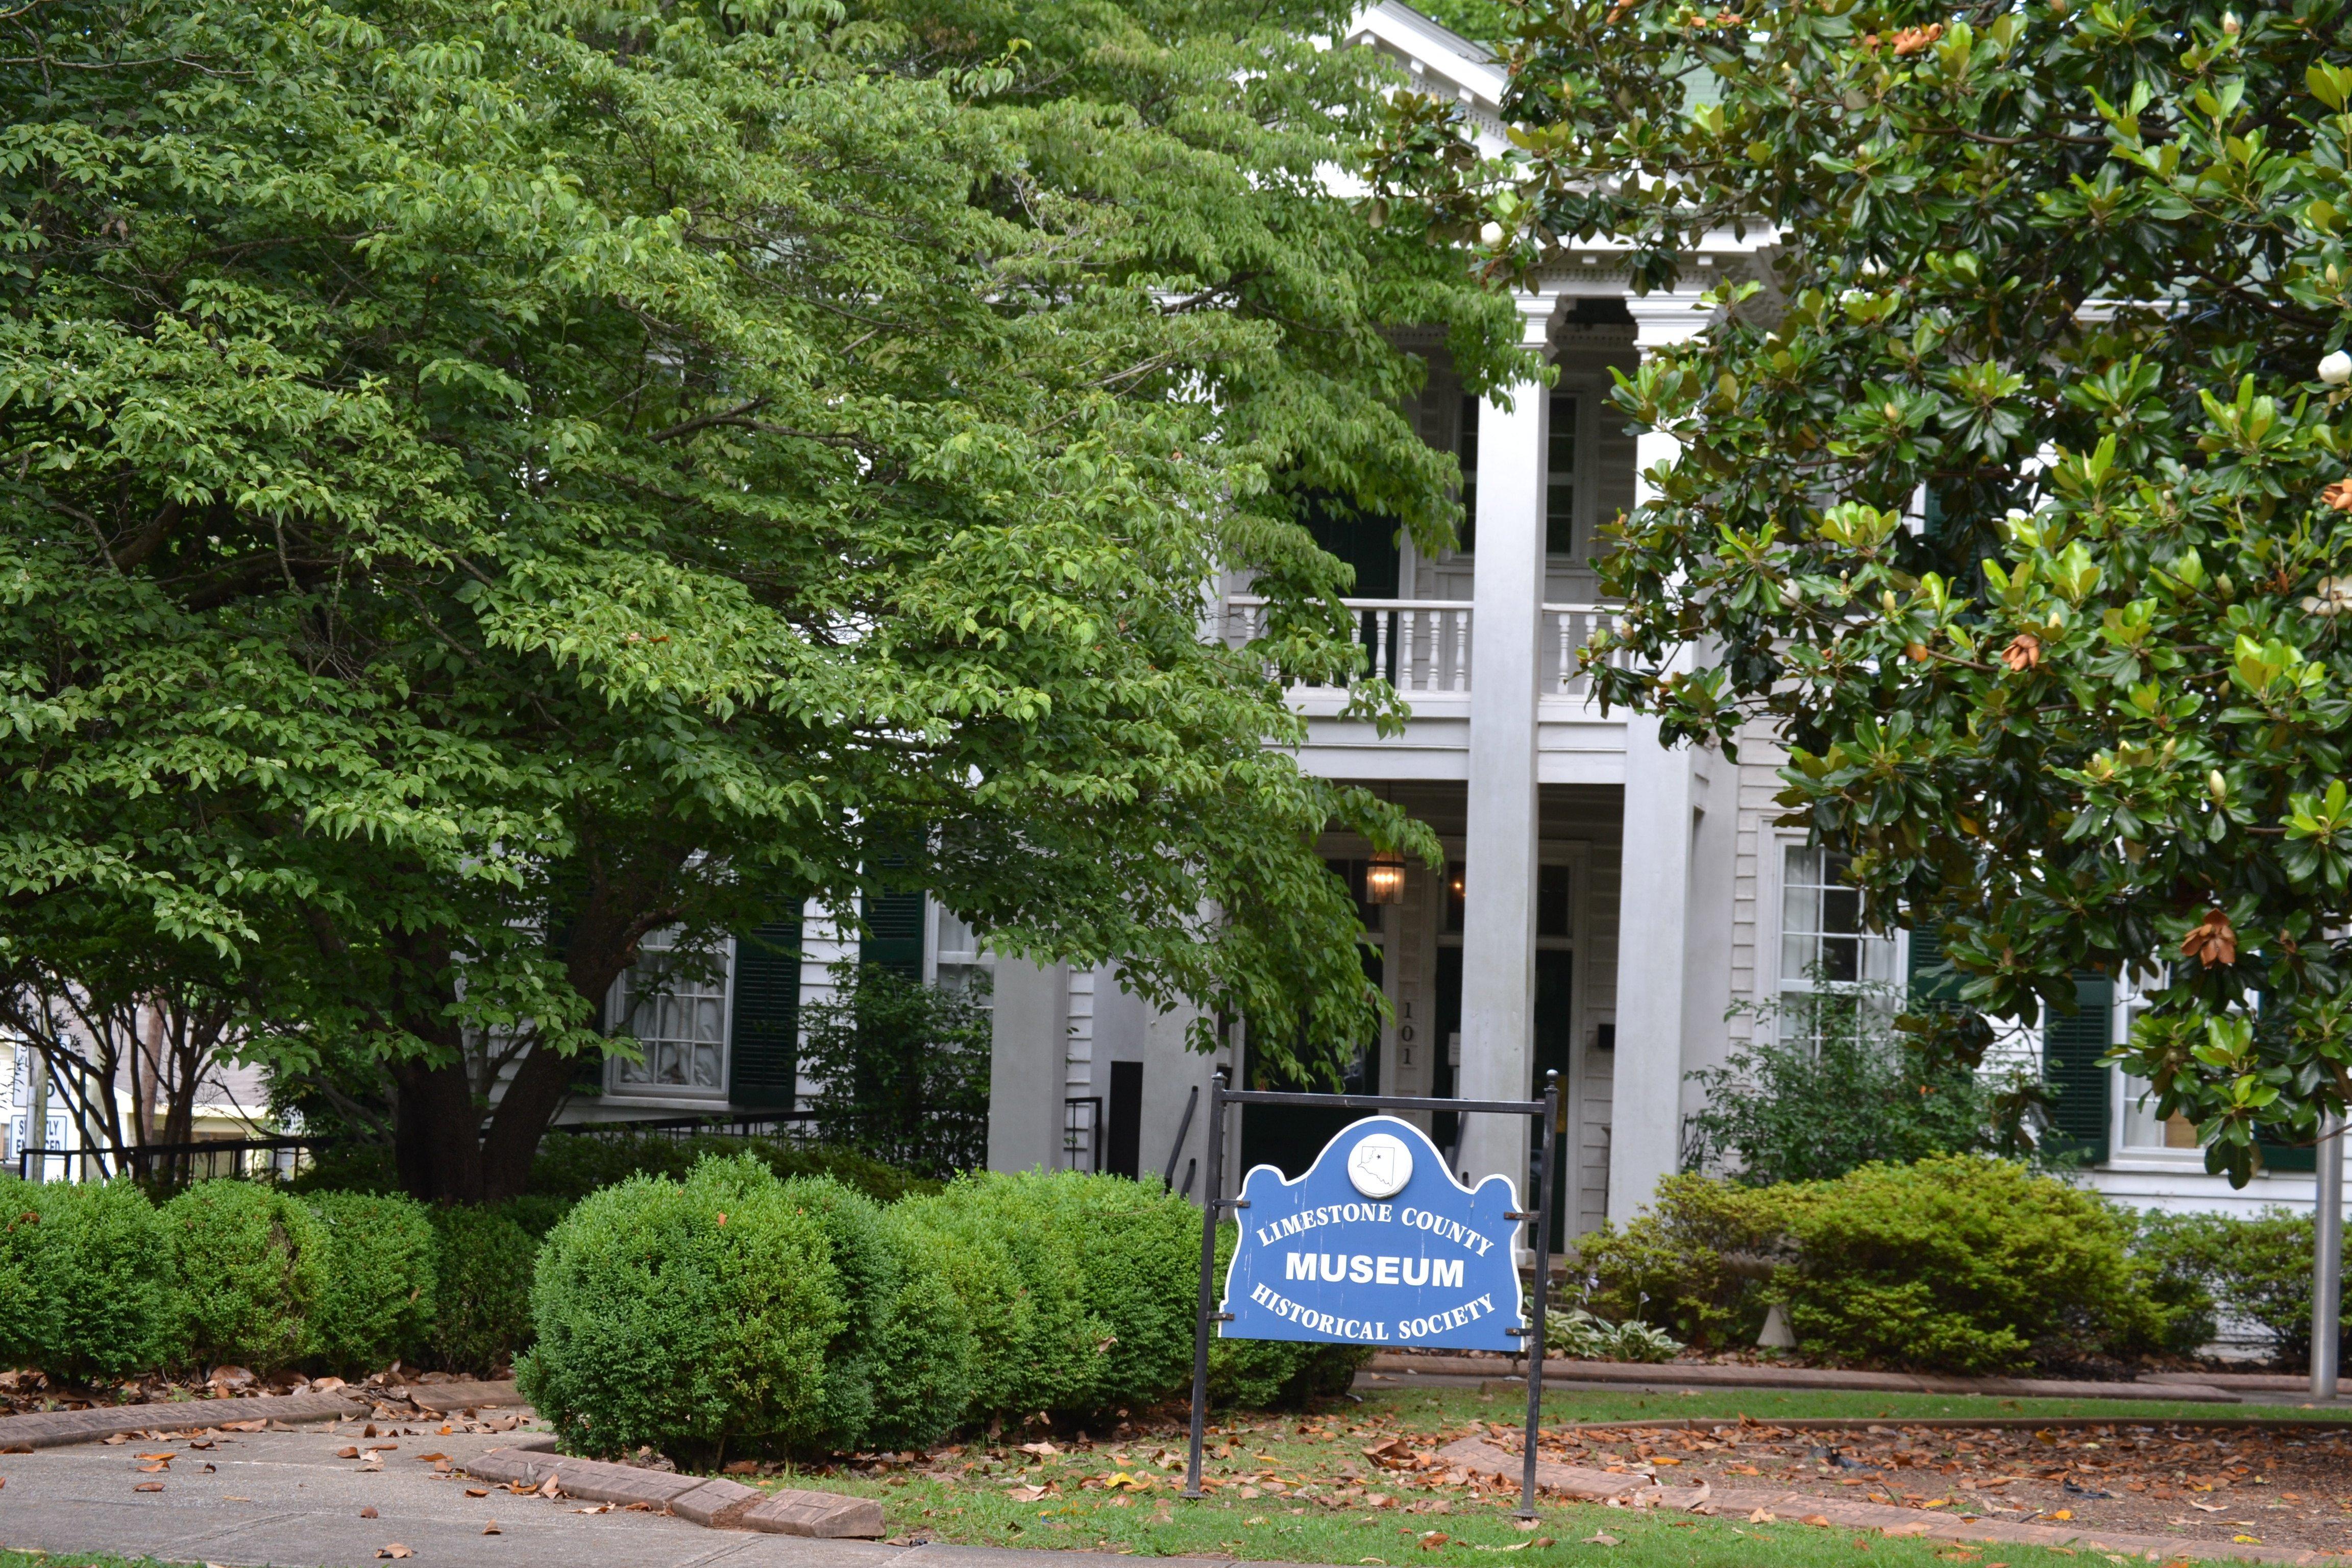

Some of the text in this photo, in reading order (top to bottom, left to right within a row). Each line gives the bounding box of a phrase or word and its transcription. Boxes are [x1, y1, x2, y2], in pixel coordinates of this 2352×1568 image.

[1402, 1002, 1413, 1064] 101
[1256, 1203, 1494, 1257] LIMESTONE COUNTY
[1285, 1252, 1464, 1288] MUSEUM
[1249, 1282, 1496, 1340] HISTORICAL SOCIETY
